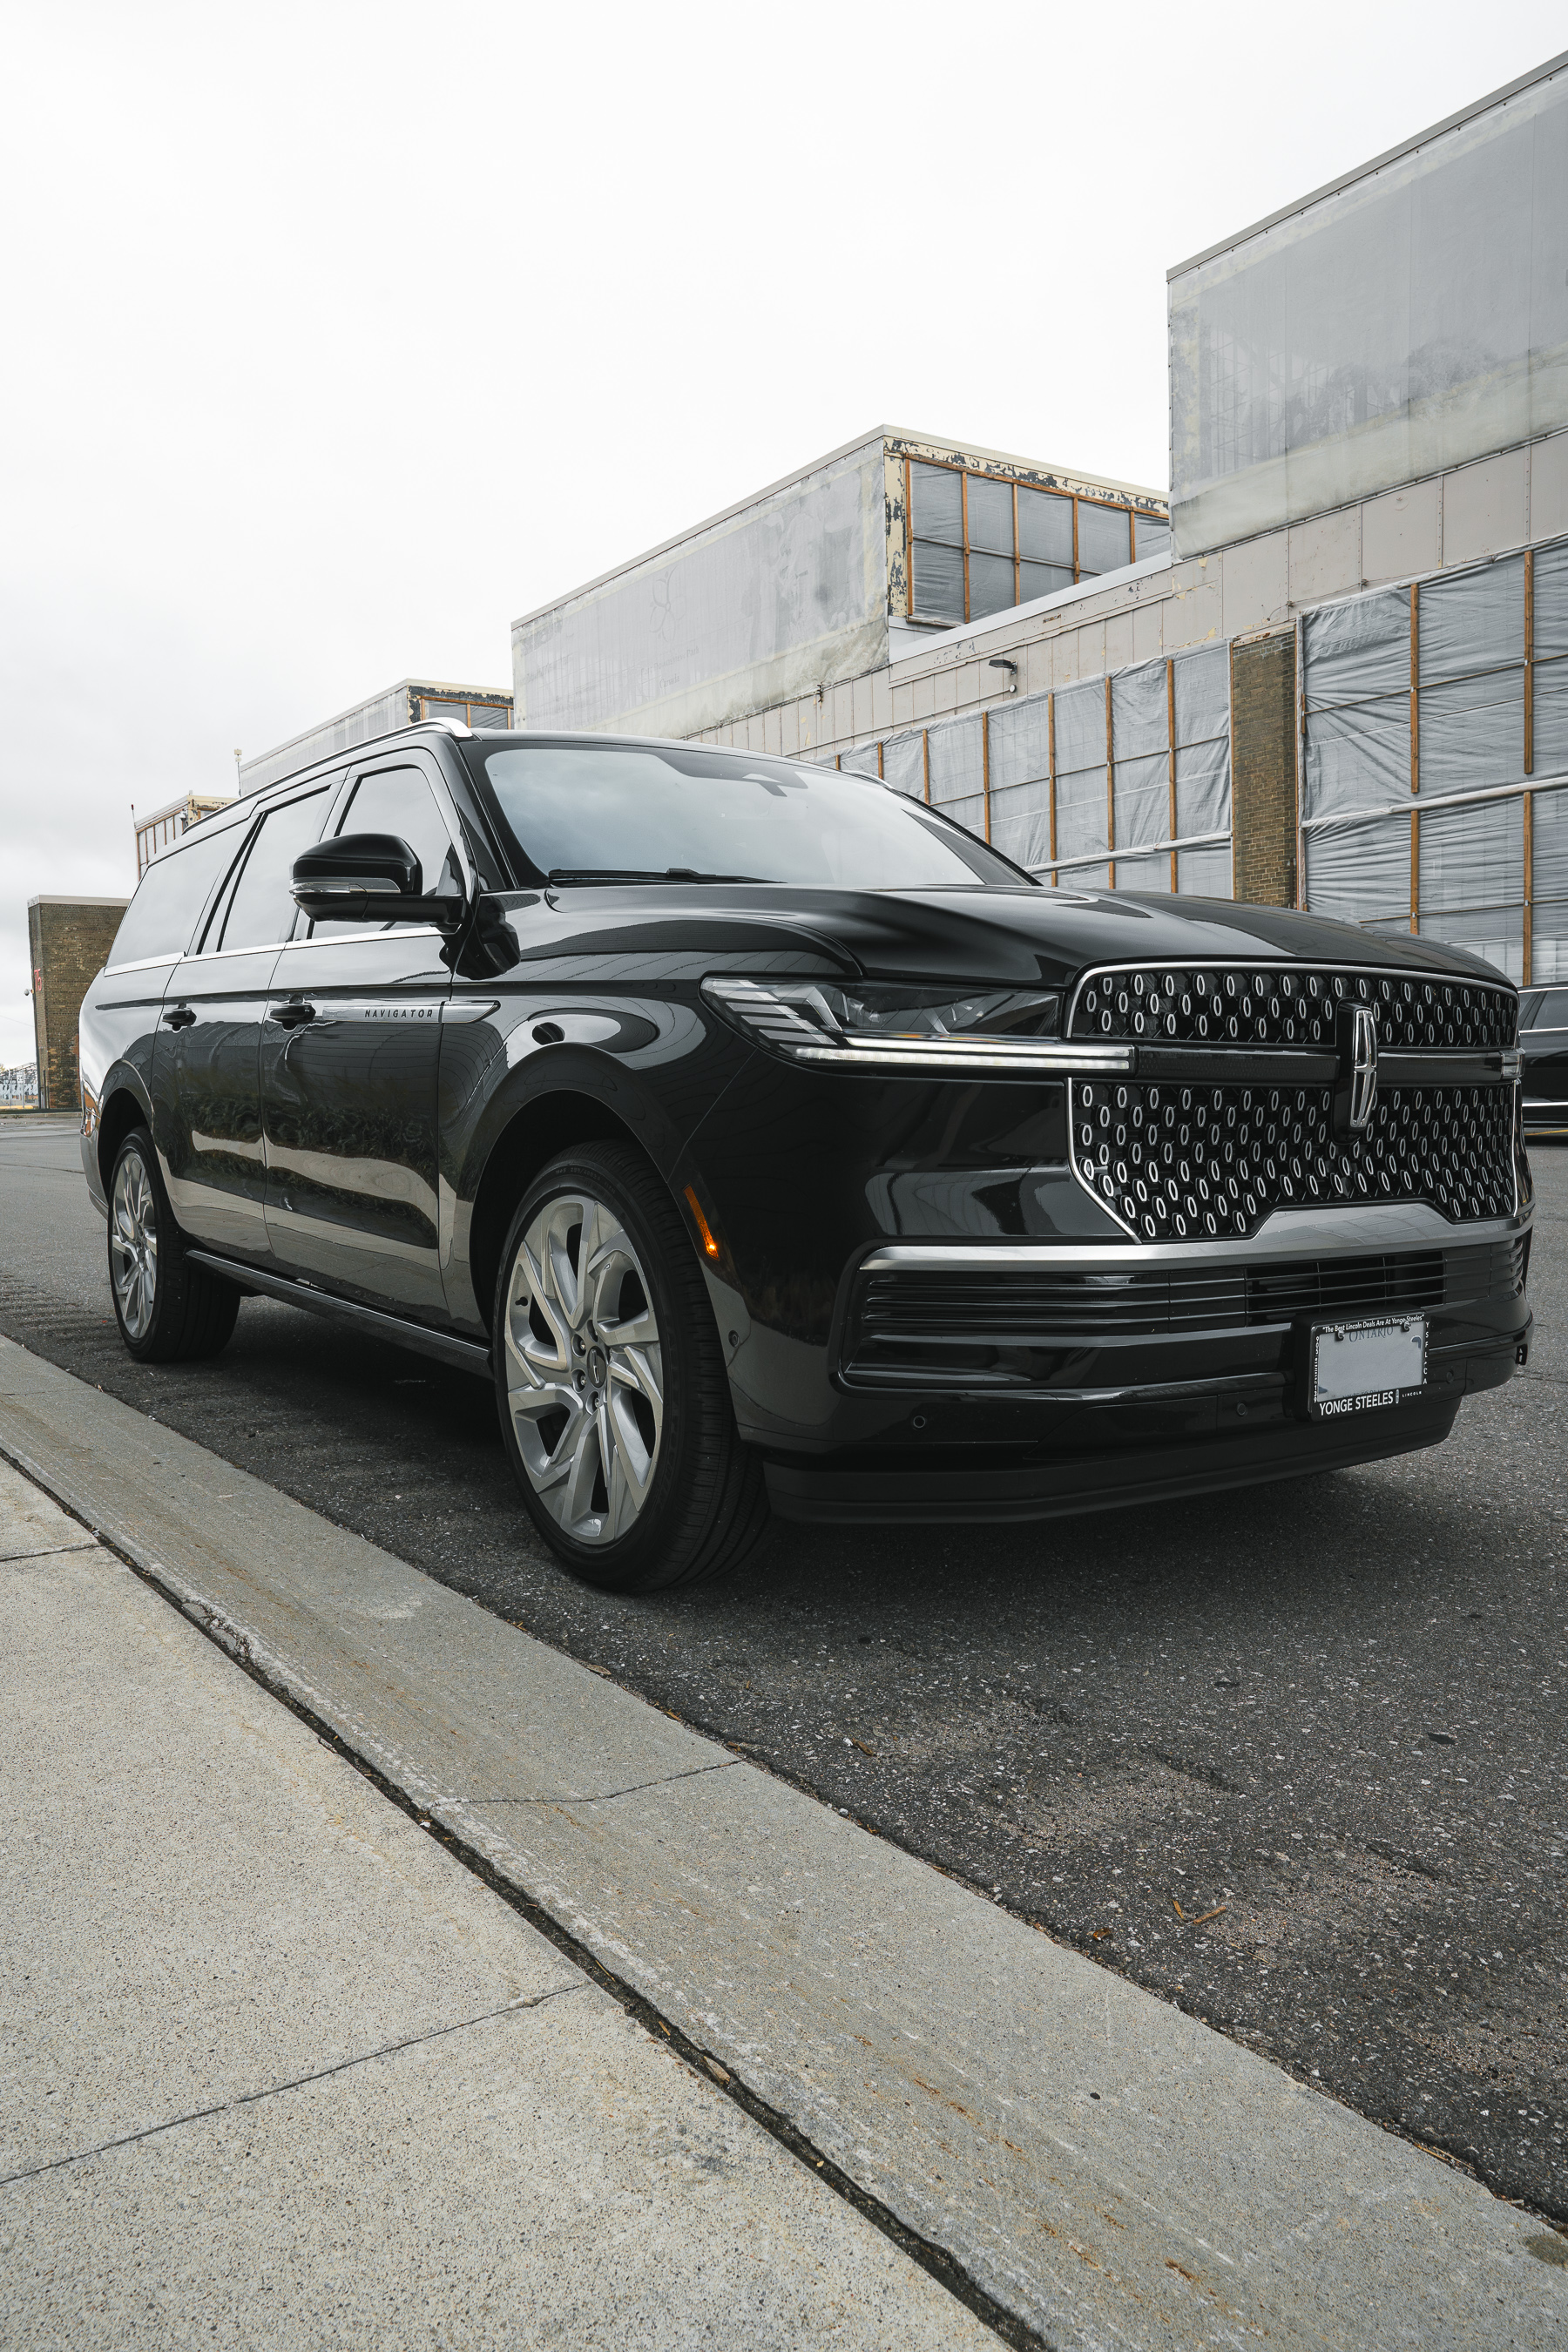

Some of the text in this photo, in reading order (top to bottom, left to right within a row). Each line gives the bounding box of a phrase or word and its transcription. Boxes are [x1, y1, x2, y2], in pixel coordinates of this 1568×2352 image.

[364, 1009, 434, 1018] NAVIGATOR
[1346, 1321, 1362, 1330] Lincoln
[1362, 1320, 1375, 1328] Deals
[1349, 1327, 1393, 1342] ONTARIO
[1319, 1399, 1353, 1416] YONGE
[1355, 1390, 1394, 1410] STEELES
